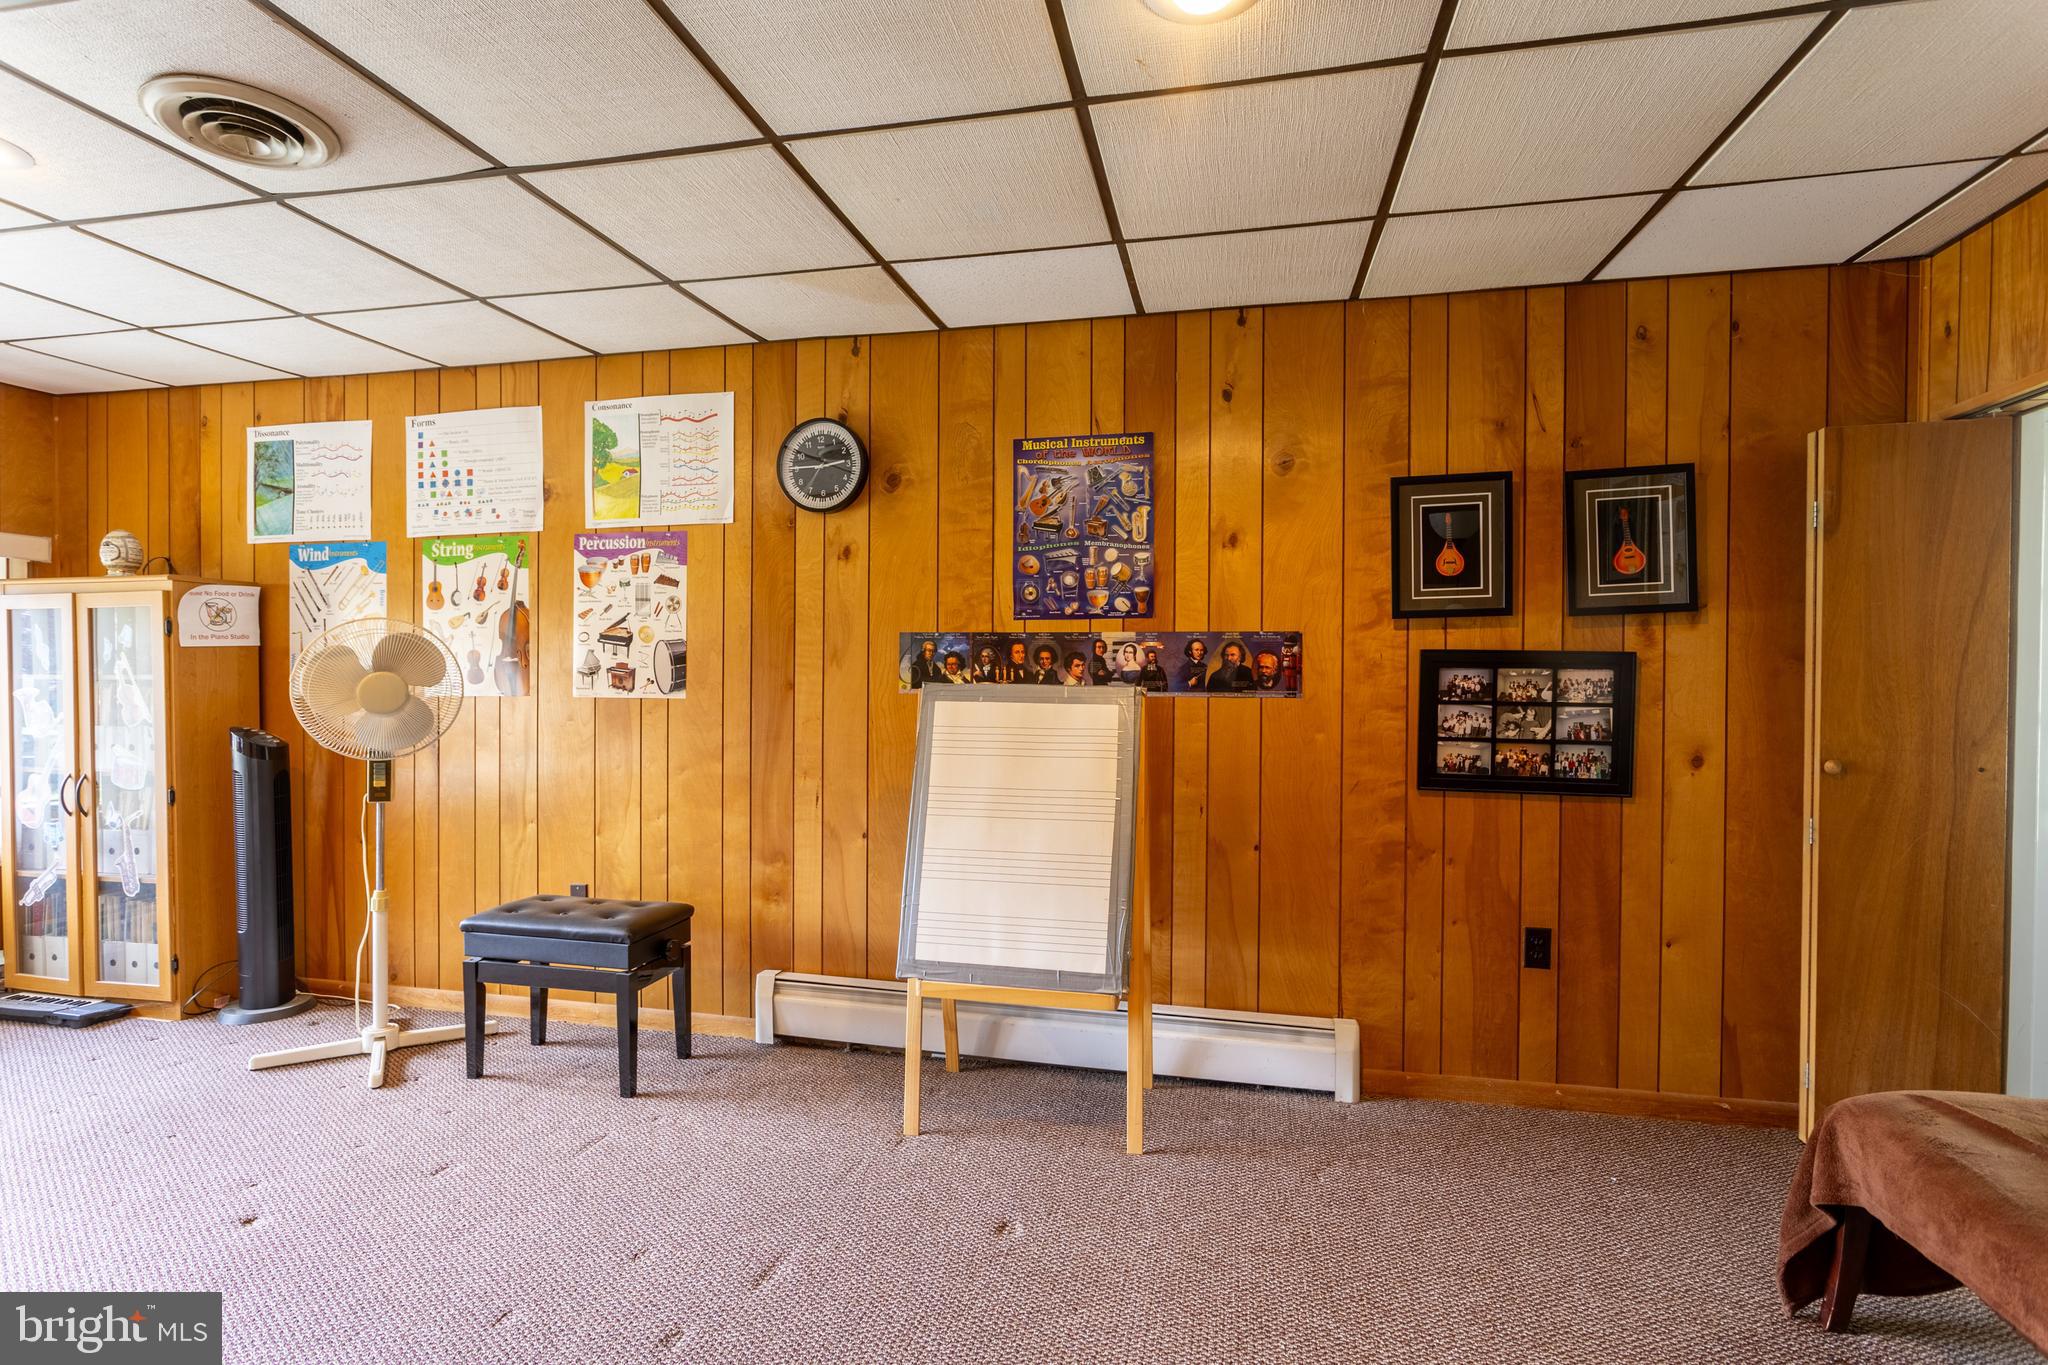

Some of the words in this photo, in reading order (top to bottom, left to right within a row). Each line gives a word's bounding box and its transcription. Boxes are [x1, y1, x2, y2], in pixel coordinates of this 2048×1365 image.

[591, 402, 633, 412] Consonance
[411, 418, 436, 428] Forms
[254, 429, 290, 438] Dissonance
[1022, 438, 1068, 451] Musical
[1071, 435, 1145, 448] Instruments
[1035, 449, 1049, 459] of
[1053, 448, 1076, 459] the
[1081, 445, 1132, 457] WORLD
[1016, 458, 1082, 467] Chordophones
[578, 534, 647, 550] Percussion
[1017, 540, 1080, 552] Idiophones
[1084, 540, 1150, 550] Membranophones
[297, 546, 329, 562] Wind
[431, 542, 474, 559] String
